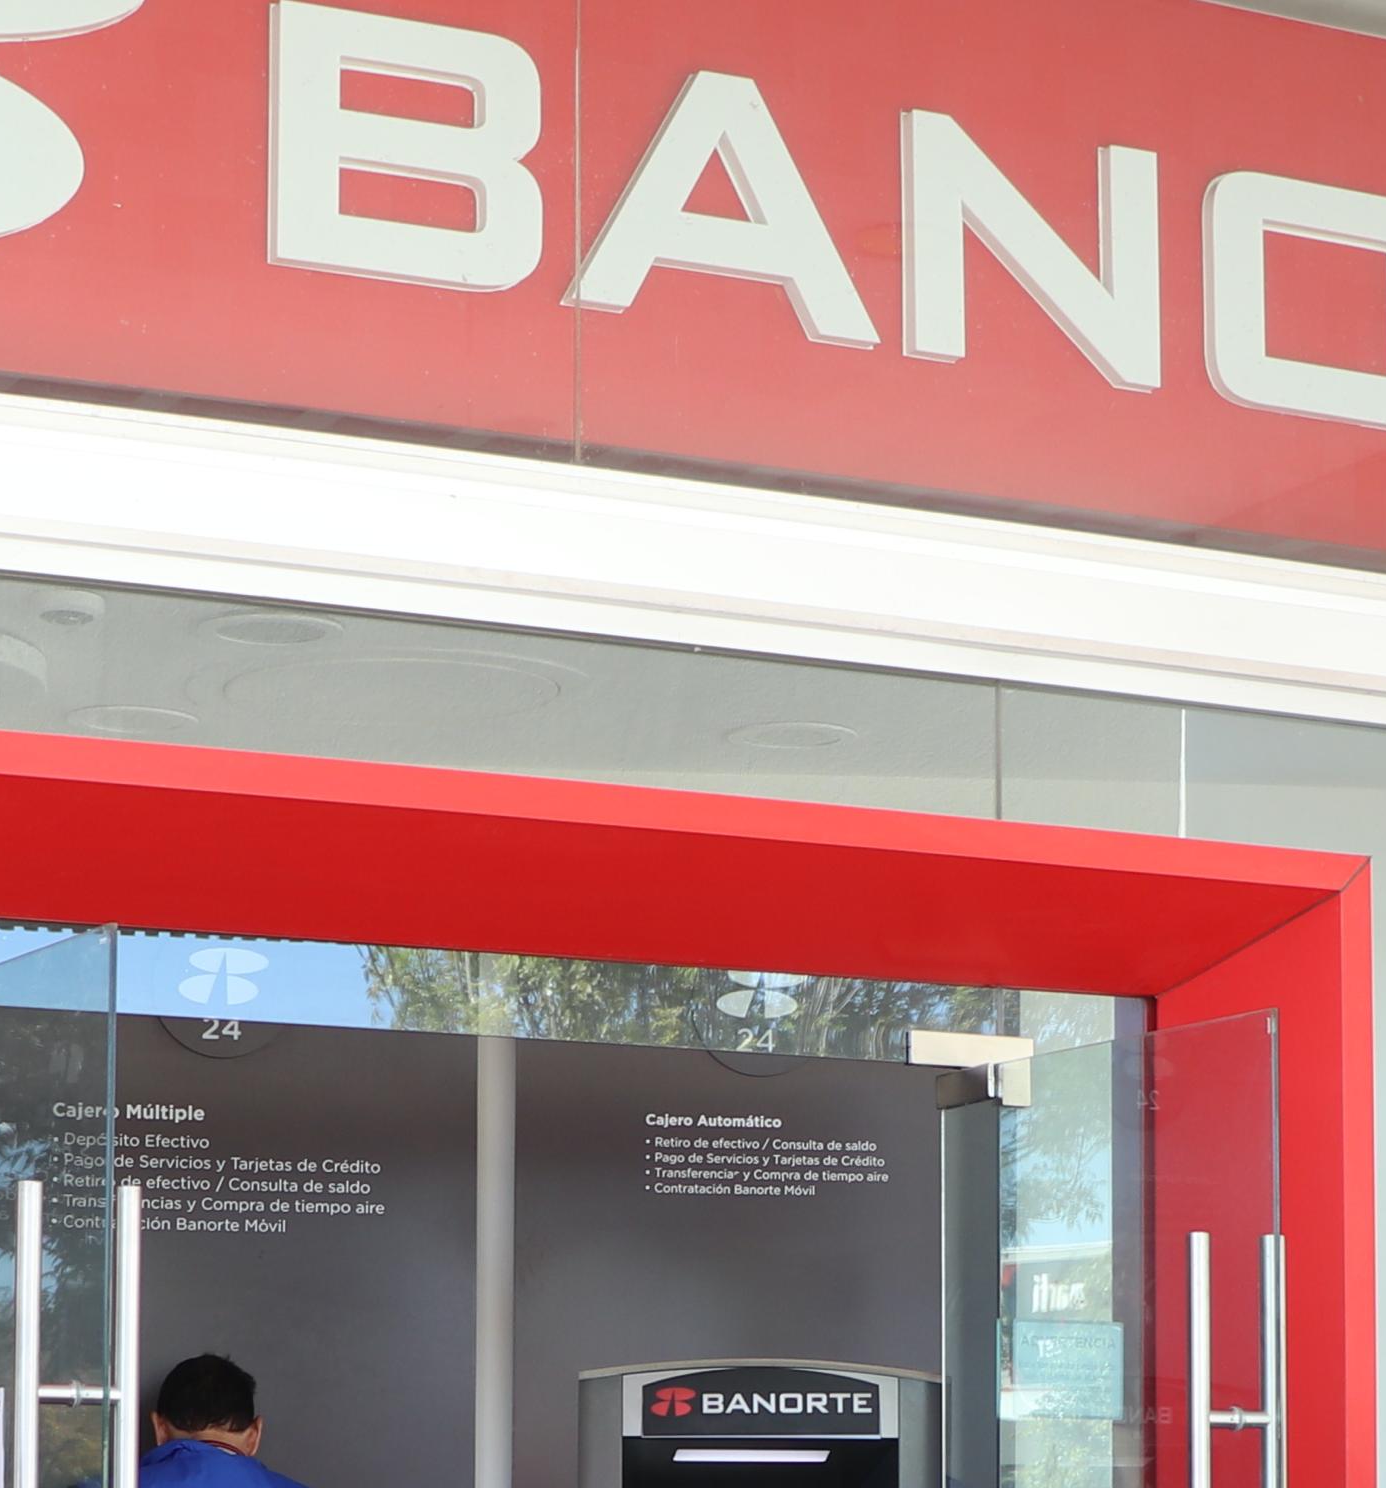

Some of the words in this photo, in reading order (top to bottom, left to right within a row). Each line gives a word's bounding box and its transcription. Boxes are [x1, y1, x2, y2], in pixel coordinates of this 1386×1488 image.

[202, 1018, 242, 1041] 24
[735, 1028, 776, 1054] 24
[52, 1102, 120, 1121] Cajero
[126, 1103, 205, 1124] Múltiple
[645, 1113, 693, 1129] Cajero
[697, 1113, 782, 1129] Automático
[144, 1133, 210, 1149] Efectivo
[654, 1136, 691, 1149] Retiro
[693, 1137, 709, 1149] de
[712, 1137, 760, 1150] efectivo
[762, 1137, 770, 1150] /
[772, 1138, 824, 1151] Consulta
[827, 1140, 842, 1151] de
[845, 1140, 877, 1152] saldo
[63, 1152, 105, 1169] Pago
[114, 1154, 134, 1168] de
[139, 1154, 211, 1170] Servicios
[216, 1159, 226, 1173] y
[231, 1156, 292, 1174] Tarjetas
[297, 1158, 317, 1172] de
[322, 1158, 381, 1174] Crédito
[654, 1152, 685, 1165] Pago
[688, 1152, 703, 1164] de
[706, 1153, 759, 1165] Servicios
[762, 1156, 770, 1167] y
[773, 1154, 820, 1167] Tarjetas
[823, 1155, 838, 1166] de
[841, 1155, 885, 1167] Crédito
[63, 1173, 116, 1188] Retiro
[121, 1175, 141, 1187] de
[146, 1175, 211, 1190] efectivo
[215, 1176, 225, 1192] /
[228, 1177, 298, 1193] Consulta
[303, 1179, 323, 1193] de
[328, 1180, 371, 1194] saldo
[743, 1171, 751, 1182] y
[753, 1169, 801, 1182] Compra
[804, 1170, 819, 1181] de
[822, 1171, 864, 1184] tiempo
[866, 1171, 889, 1182] aire
[654, 1182, 731, 1195] Contratación
[734, 1183, 781, 1196] Banorte
[784, 1184, 815, 1196] Móvil
[186, 1199, 197, 1213] y
[201, 1197, 265, 1214] Compra
[269, 1199, 290, 1213] de
[294, 1199, 351, 1216] tiempo
[355, 1201, 385, 1215] aire
[176, 1217, 240, 1232] Banorte
[244, 1217, 287, 1233] Móvil
[702, 1392, 873, 1415] BANORTE
